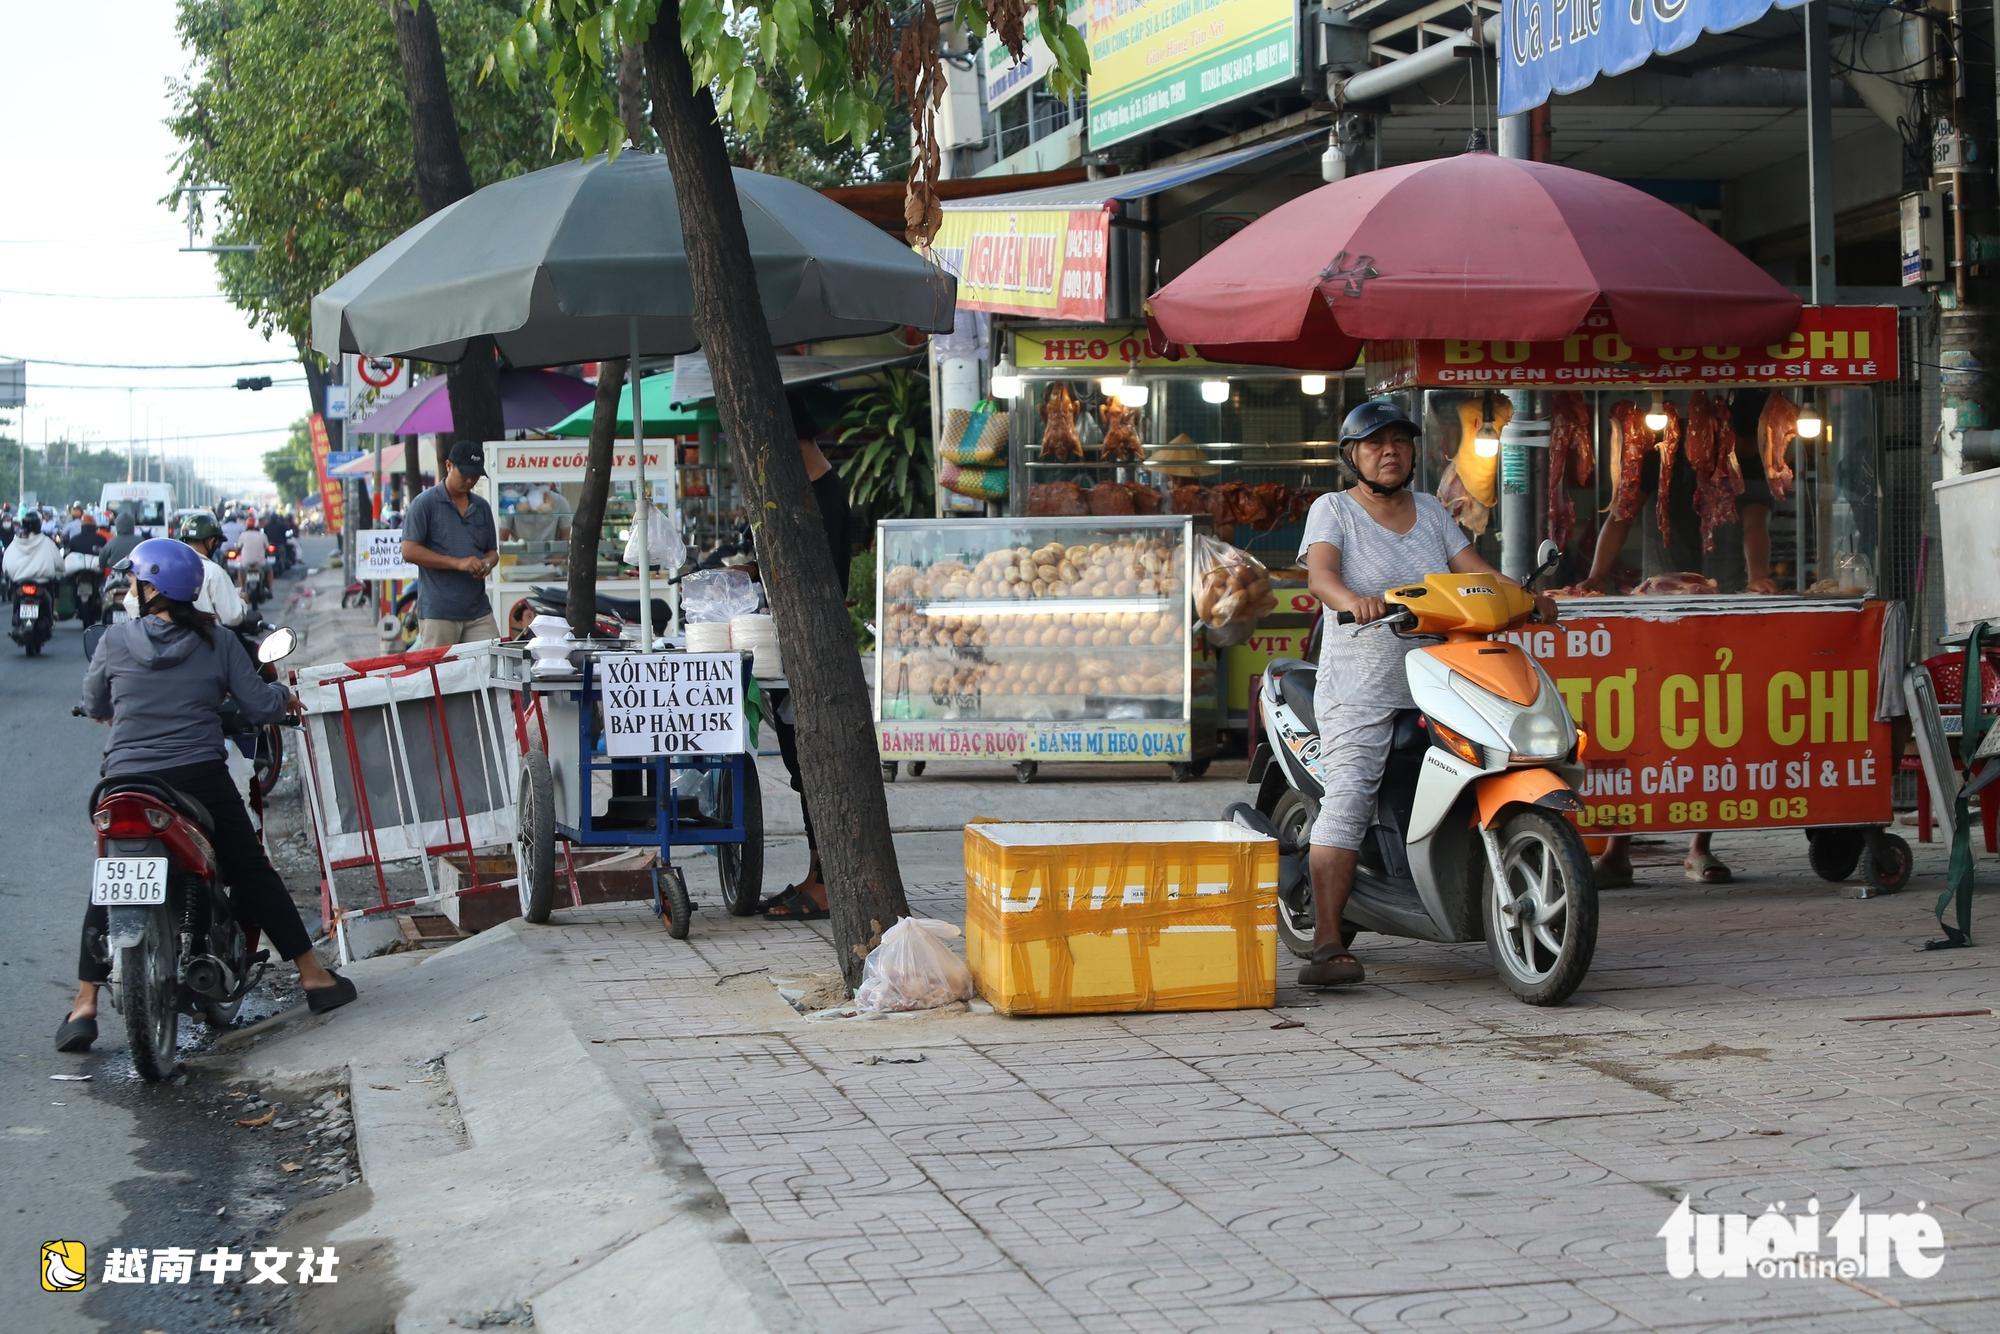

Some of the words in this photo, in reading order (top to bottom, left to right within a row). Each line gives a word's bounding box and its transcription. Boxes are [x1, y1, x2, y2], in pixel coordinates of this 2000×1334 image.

[1043, 339, 1109, 361] HEO
[1767, 331, 1870, 360] CHI
[1438, 366, 1546, 381] CHUYÊN
[1701, 362, 1736, 376] BÒ
[1744, 363, 1777, 376] TƠ
[1820, 364, 1839, 375] &
[506, 453, 549, 469] BÁNH
[1248, 636, 1292, 656] VỊT
[1567, 623, 1611, 658] BÒ
[608, 657, 641, 684] XÔI
[645, 656, 680, 683] NẾP
[683, 660, 733, 682] THAN
[609, 684, 646, 709] XÔI
[652, 683, 680, 707] LÁ
[1556, 668, 1638, 752] TƠ
[1660, 647, 1744, 750] CỦ
[1767, 669, 1869, 746] CHI
[611, 709, 645, 734] BẮP
[650, 708, 695, 733] HẦM
[701, 712, 733, 732] 15K
[650, 733, 704, 753] 10K
[882, 727, 925, 752] BÁNH
[1108, 733, 1139, 752] HEO
[1142, 733, 1186, 757] QUAY
[1428, 756, 1458, 776] HONDA
[1579, 768, 1632, 796] UNG
[1641, 757, 1694, 795] CẤP
[1703, 757, 1738, 792] BÒ
[1745, 759, 1778, 791] TƠ
[1785, 752, 1811, 789] SỈ
[1820, 760, 1839, 787] &
[1848, 749, 1877, 786] LẺ
[1576, 803, 1653, 827] 0981
[1669, 801, 1709, 824] 88
[1719, 799, 1759, 821] 69
[1769, 796, 1809, 819] 03
[106, 861, 157, 880] 59-L2
[99, 882, 161, 901] 389.06
